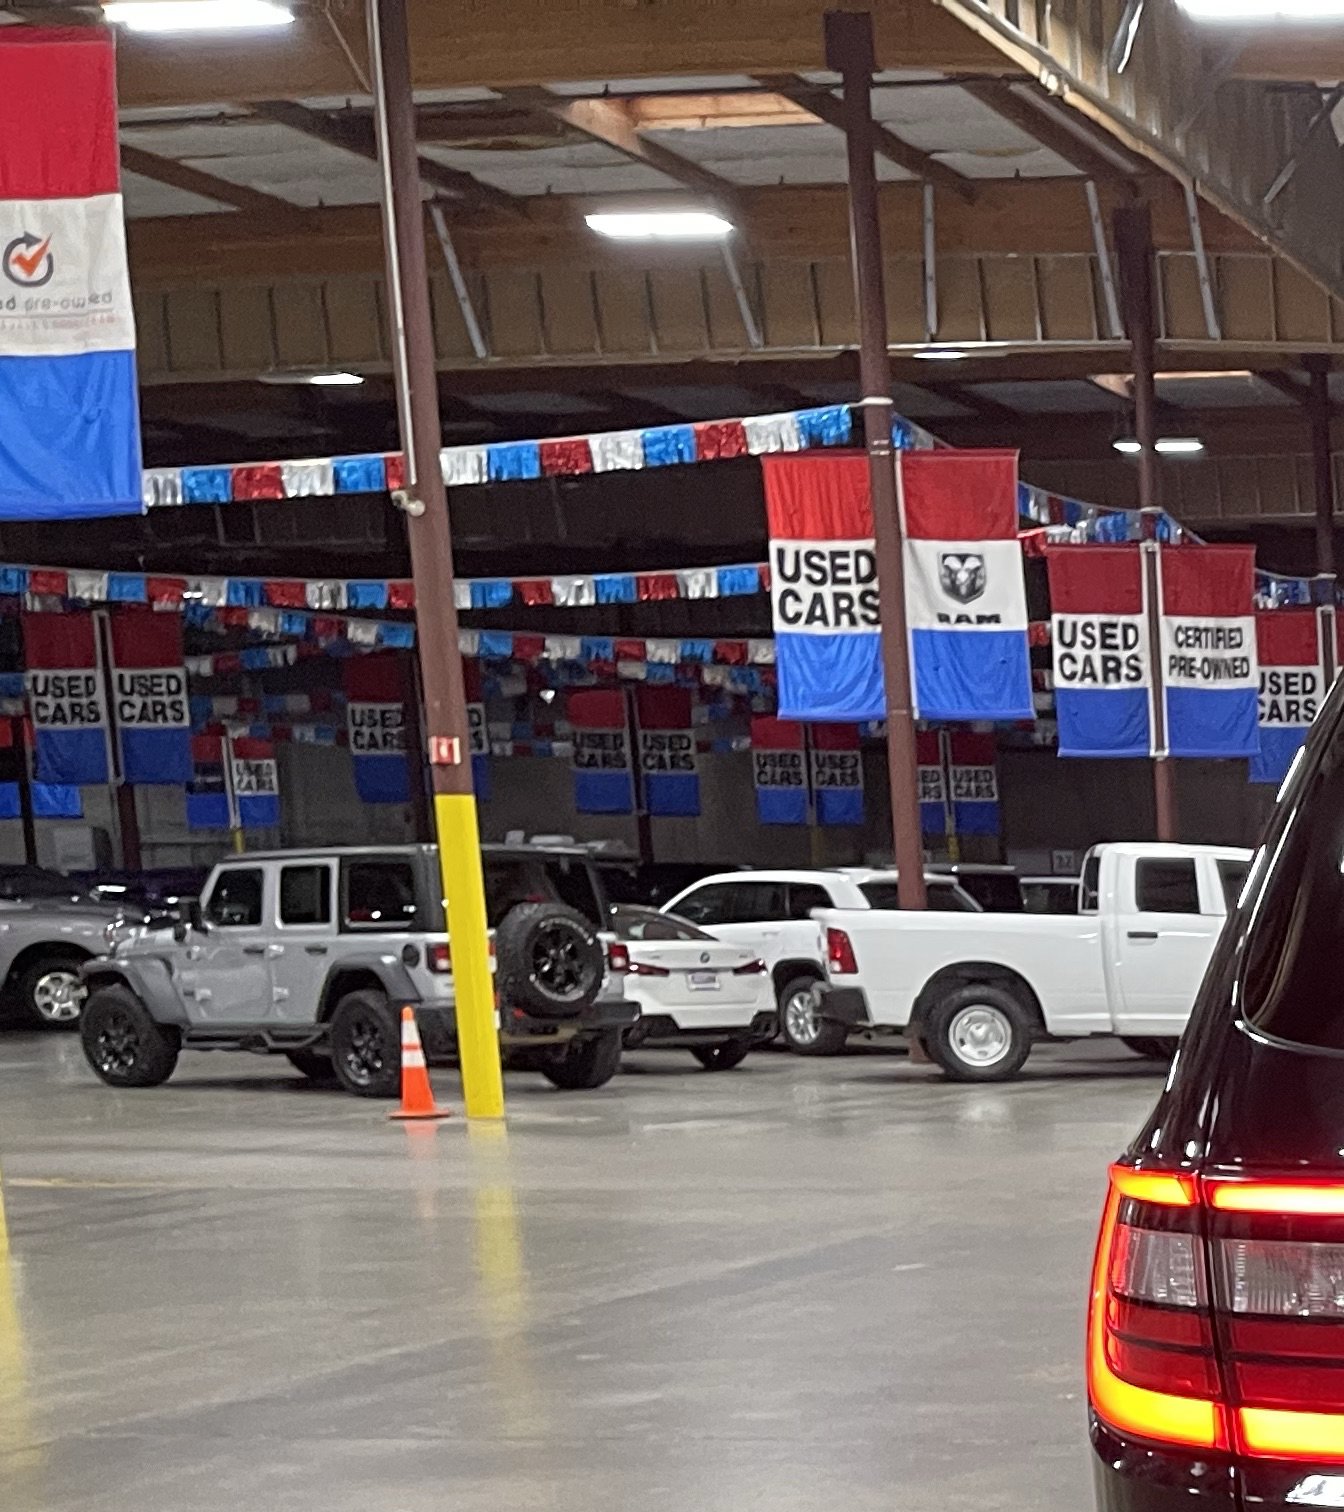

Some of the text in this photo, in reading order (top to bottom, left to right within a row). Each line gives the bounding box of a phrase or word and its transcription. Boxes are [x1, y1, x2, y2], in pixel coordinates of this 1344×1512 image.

[777, 548, 877, 586] USED
[778, 588, 881, 627] CARS
[1057, 620, 1139, 650] USED
[1174, 626, 1243, 649] CERTIFIED
[1058, 652, 1143, 683] CARS
[1168, 654, 1250, 680] PRE-OWNED
[32, 674, 97, 698] USED
[118, 673, 183, 696] USED
[34, 701, 101, 723] CARS
[119, 701, 184, 723] CARS
[953, 769, 993, 784] USED
[954, 785, 995, 799] CARS
